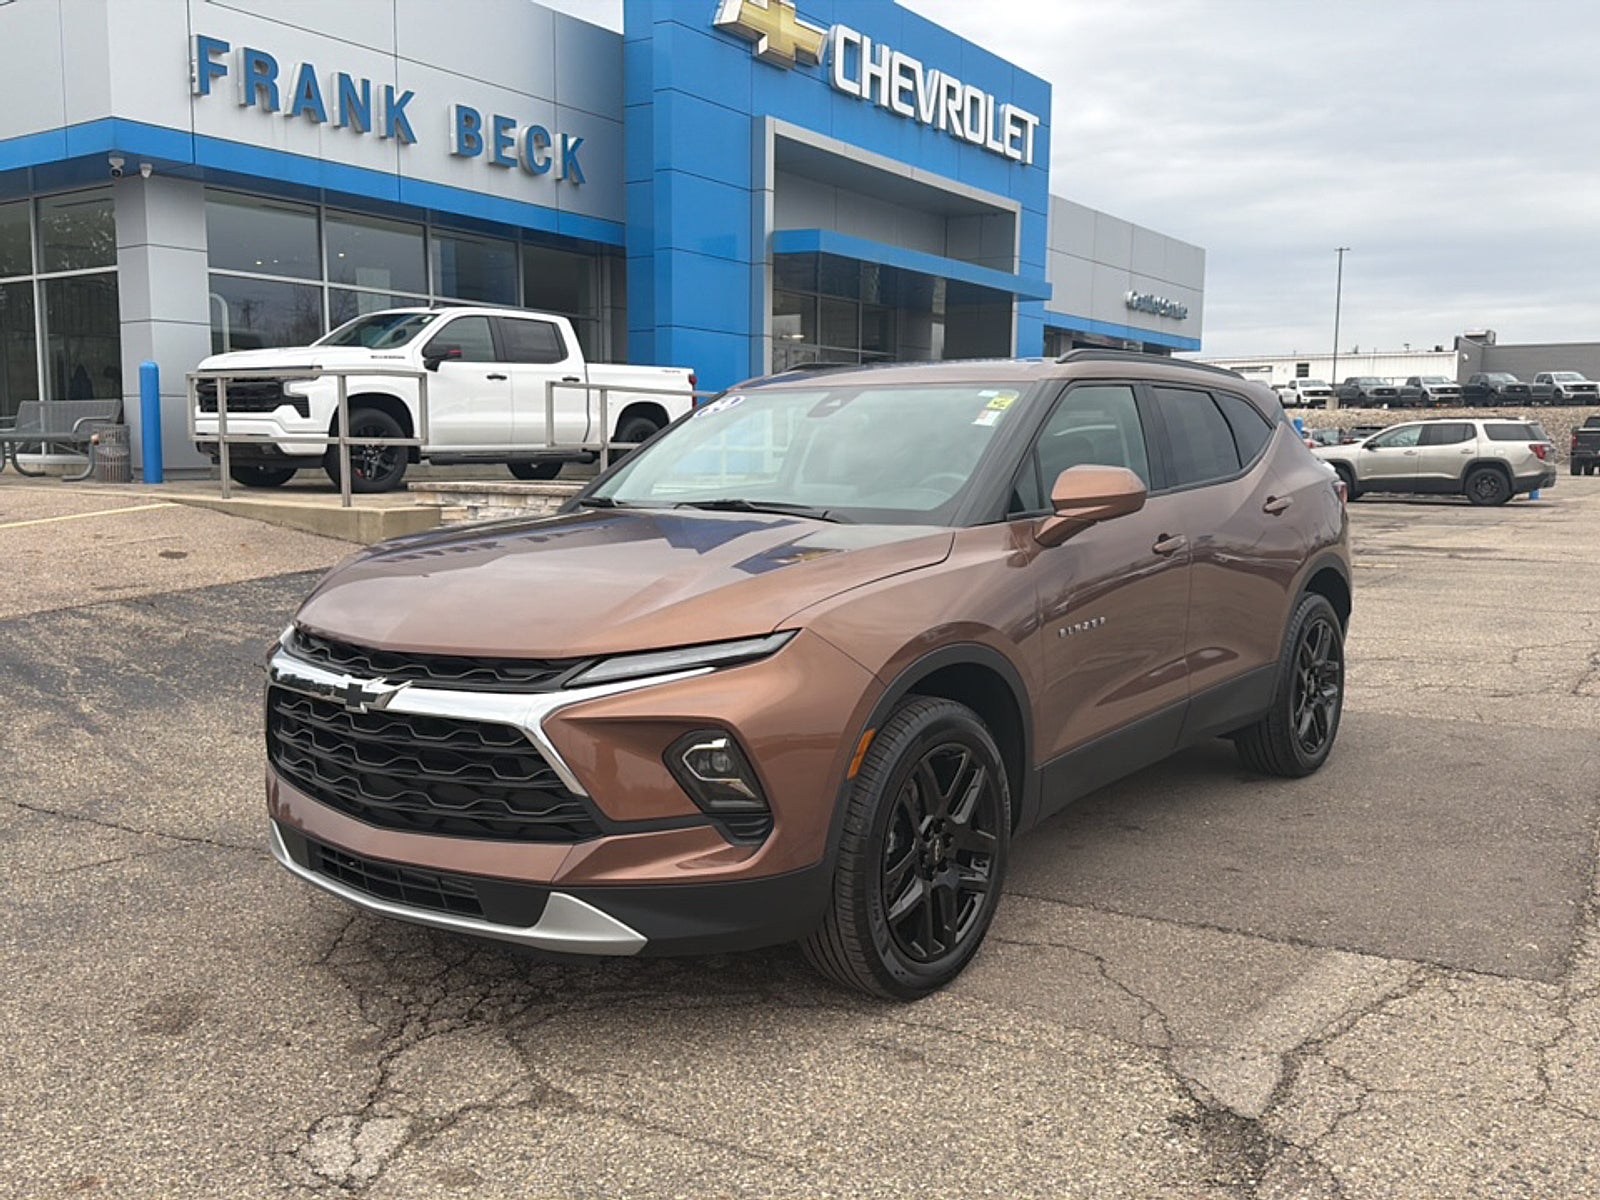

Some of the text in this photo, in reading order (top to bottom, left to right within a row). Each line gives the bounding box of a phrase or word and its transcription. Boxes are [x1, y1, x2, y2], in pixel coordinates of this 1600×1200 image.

[191, 34, 586, 185] FRANK BECK
[830, 23, 1040, 165] CHEVROLET
